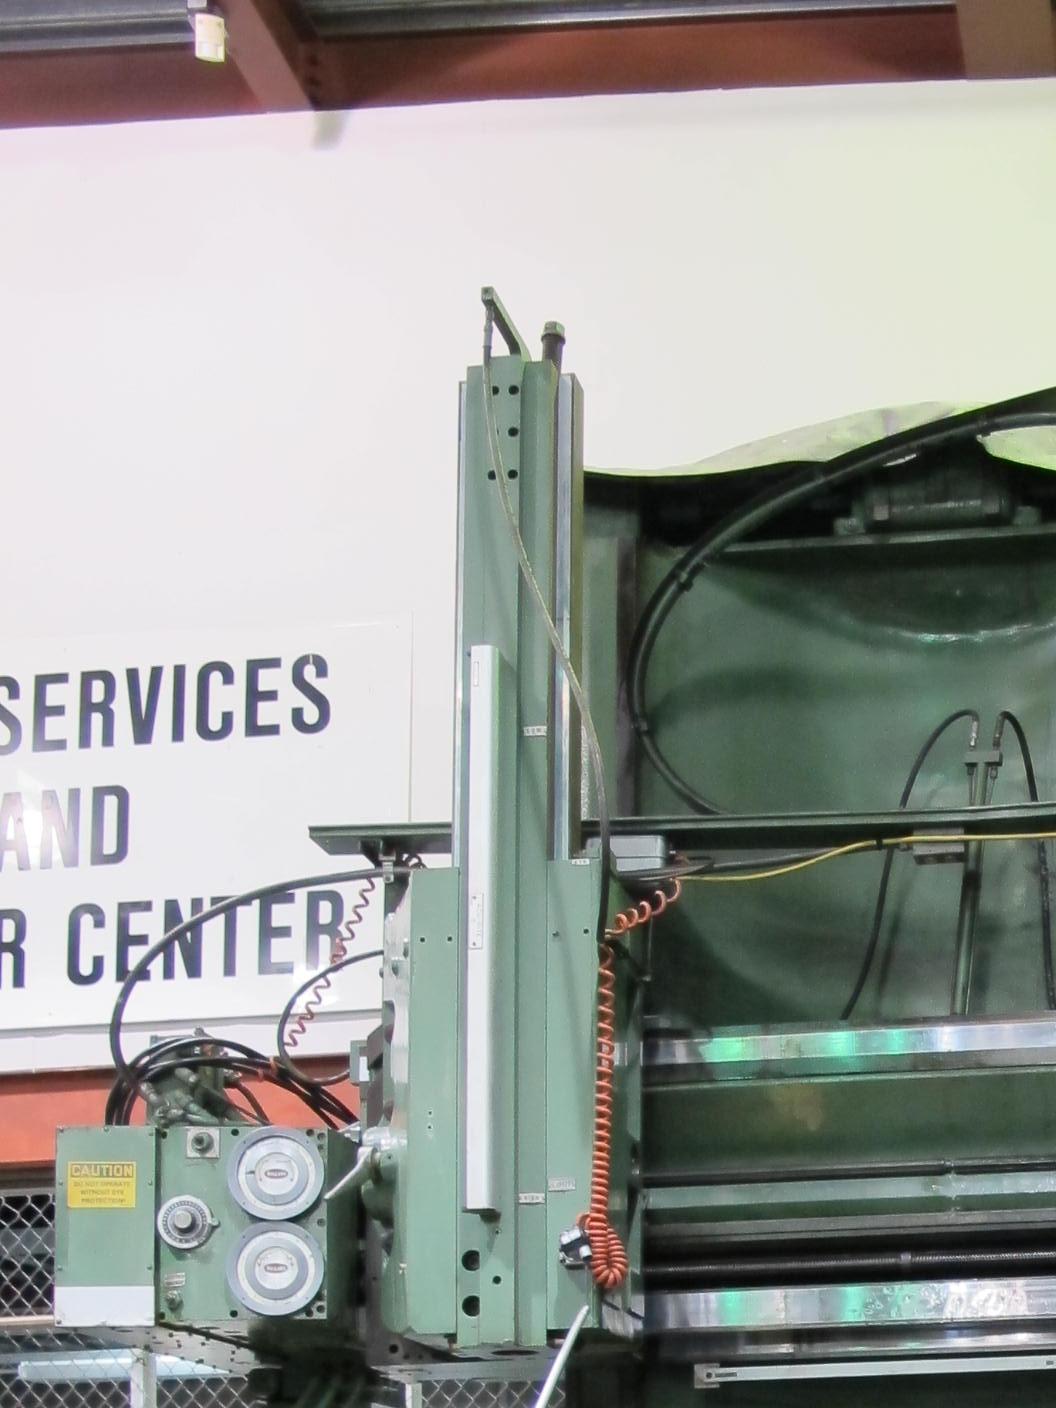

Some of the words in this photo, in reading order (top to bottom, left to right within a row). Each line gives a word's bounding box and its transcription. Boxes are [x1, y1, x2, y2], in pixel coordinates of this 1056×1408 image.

[0, 653, 331, 757] SERVICES
[0, 784, 130, 872] AND
[66, 889, 345, 985] CENTER
[72, 1164, 133, 1177] CAUTION
